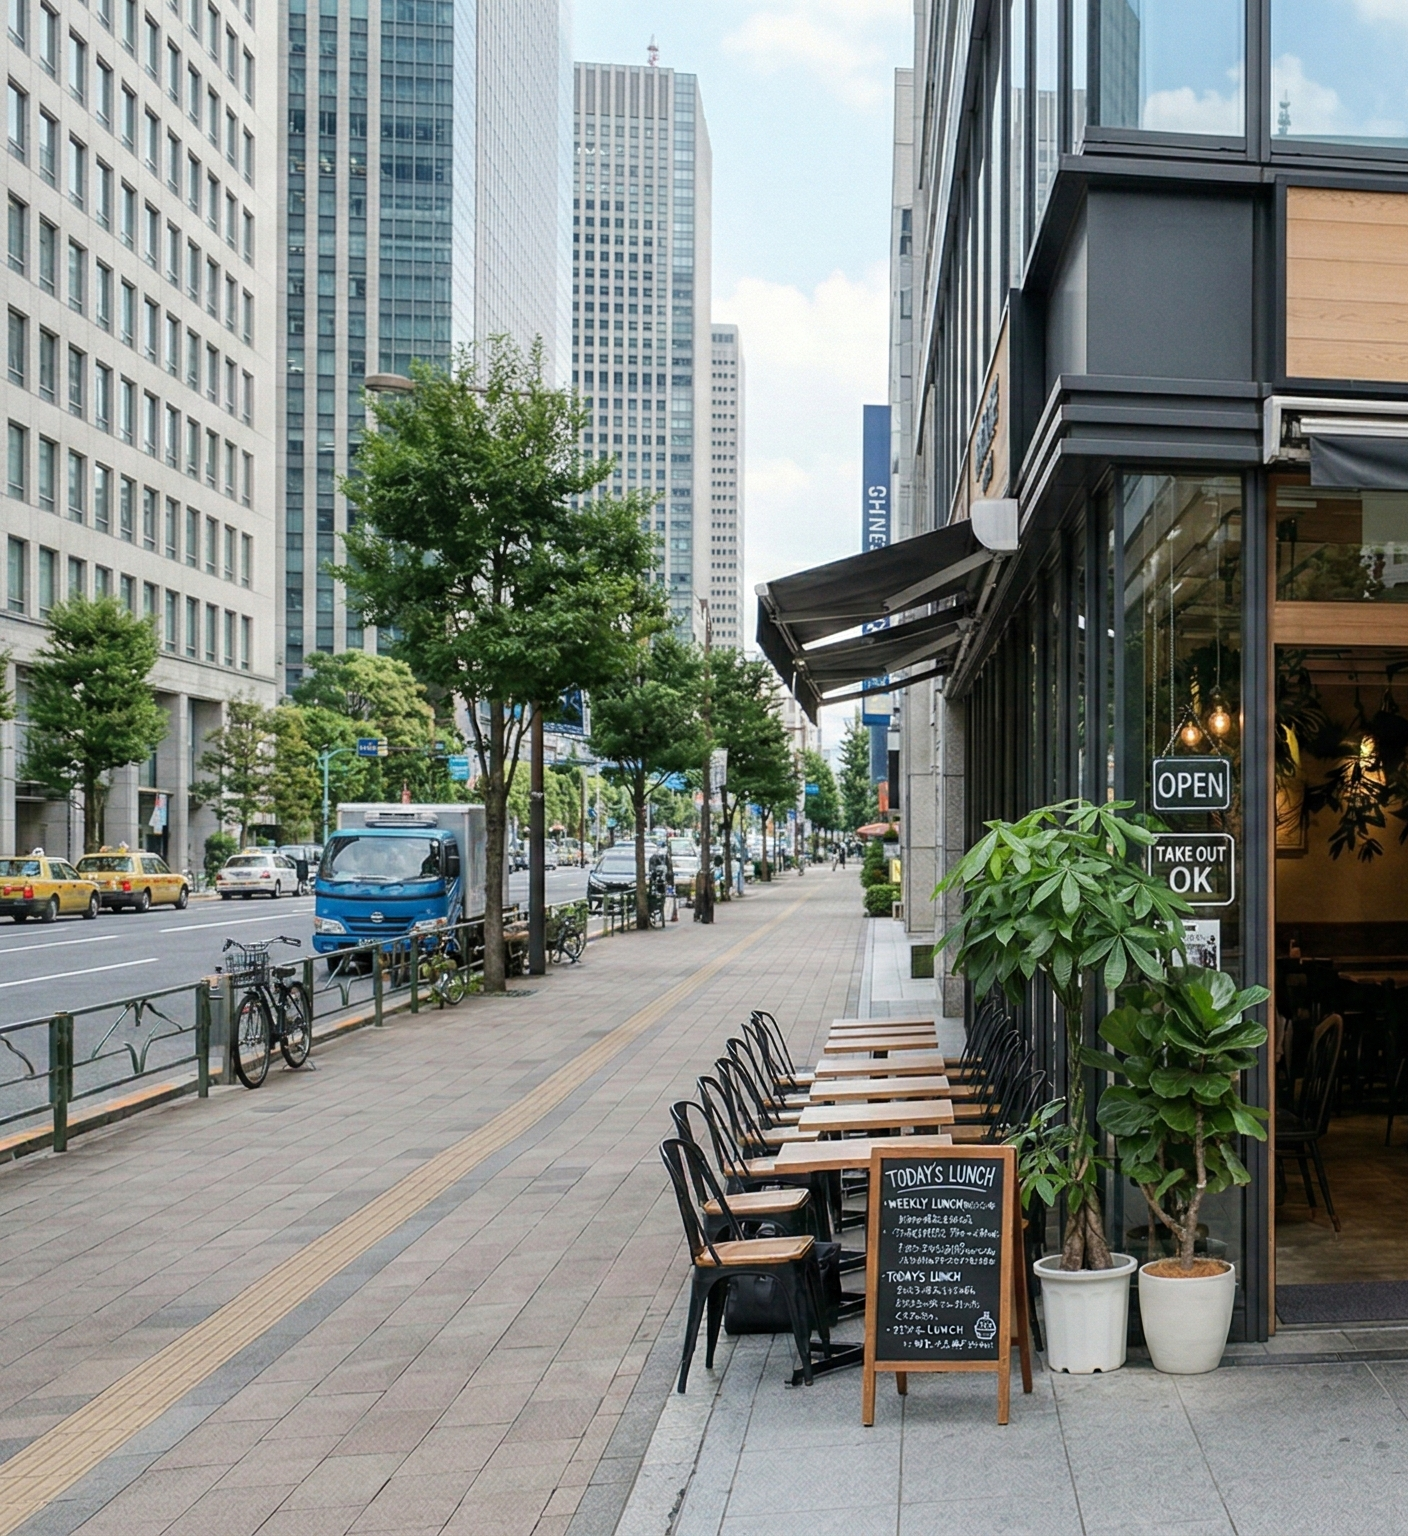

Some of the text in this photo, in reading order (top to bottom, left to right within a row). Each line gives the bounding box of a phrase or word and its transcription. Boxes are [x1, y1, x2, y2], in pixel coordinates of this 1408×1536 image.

[1158, 771, 1223, 798] OPEN
[1155, 845, 1227, 862] TAKE OUT
[1169, 866, 1213, 893] OK
[885, 1161, 996, 1188] TODAY'S LUNCH
[888, 1197, 929, 1210] WEEKLY
[931, 1197, 964, 1210] LUNCH
